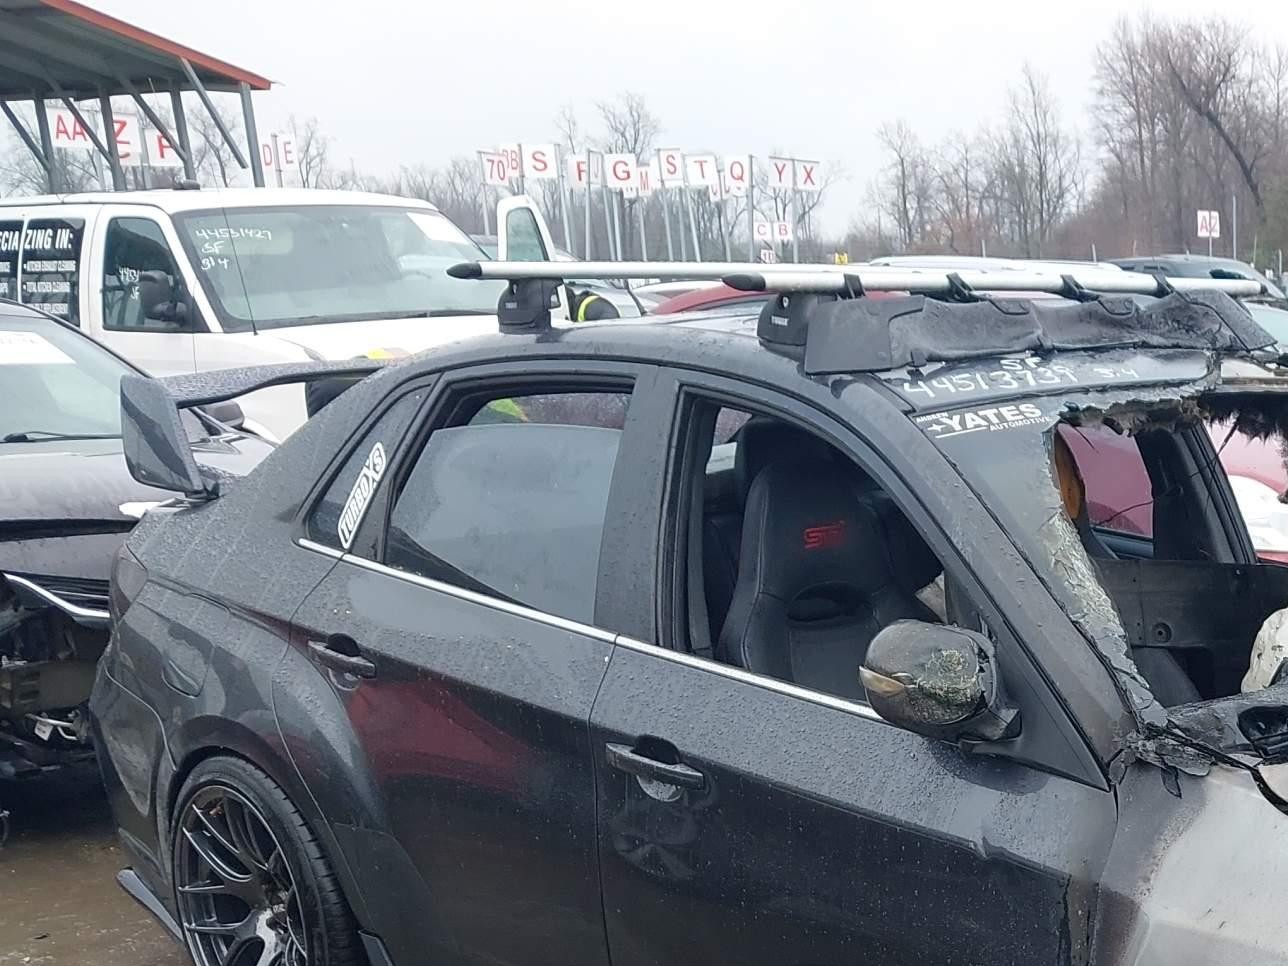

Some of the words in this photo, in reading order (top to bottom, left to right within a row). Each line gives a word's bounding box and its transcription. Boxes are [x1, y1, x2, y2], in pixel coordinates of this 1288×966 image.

[55, 114, 87, 142] AA
[112, 119, 131, 145] Z
[263, 143, 273, 166] D
[283, 141, 295, 165] E
[532, 151, 548, 172] S
[486, 158, 506, 181] 70
[612, 160, 631, 181] G
[666, 154, 677, 175] S
[694, 160, 708, 179] T
[730, 161, 745, 182] Q
[774, 162, 786, 183] Y
[803, 165, 816, 186] X
[757, 224, 767, 236] C
[779, 224, 788, 236] B
[1200, 215, 1209, 232] A
[55, 228, 73, 249] IN:
[903, 364, 1078, 398] 44513739
[939, 403, 1042, 431] YATES
[989, 416, 1051, 431] AUTOMOTIVE
